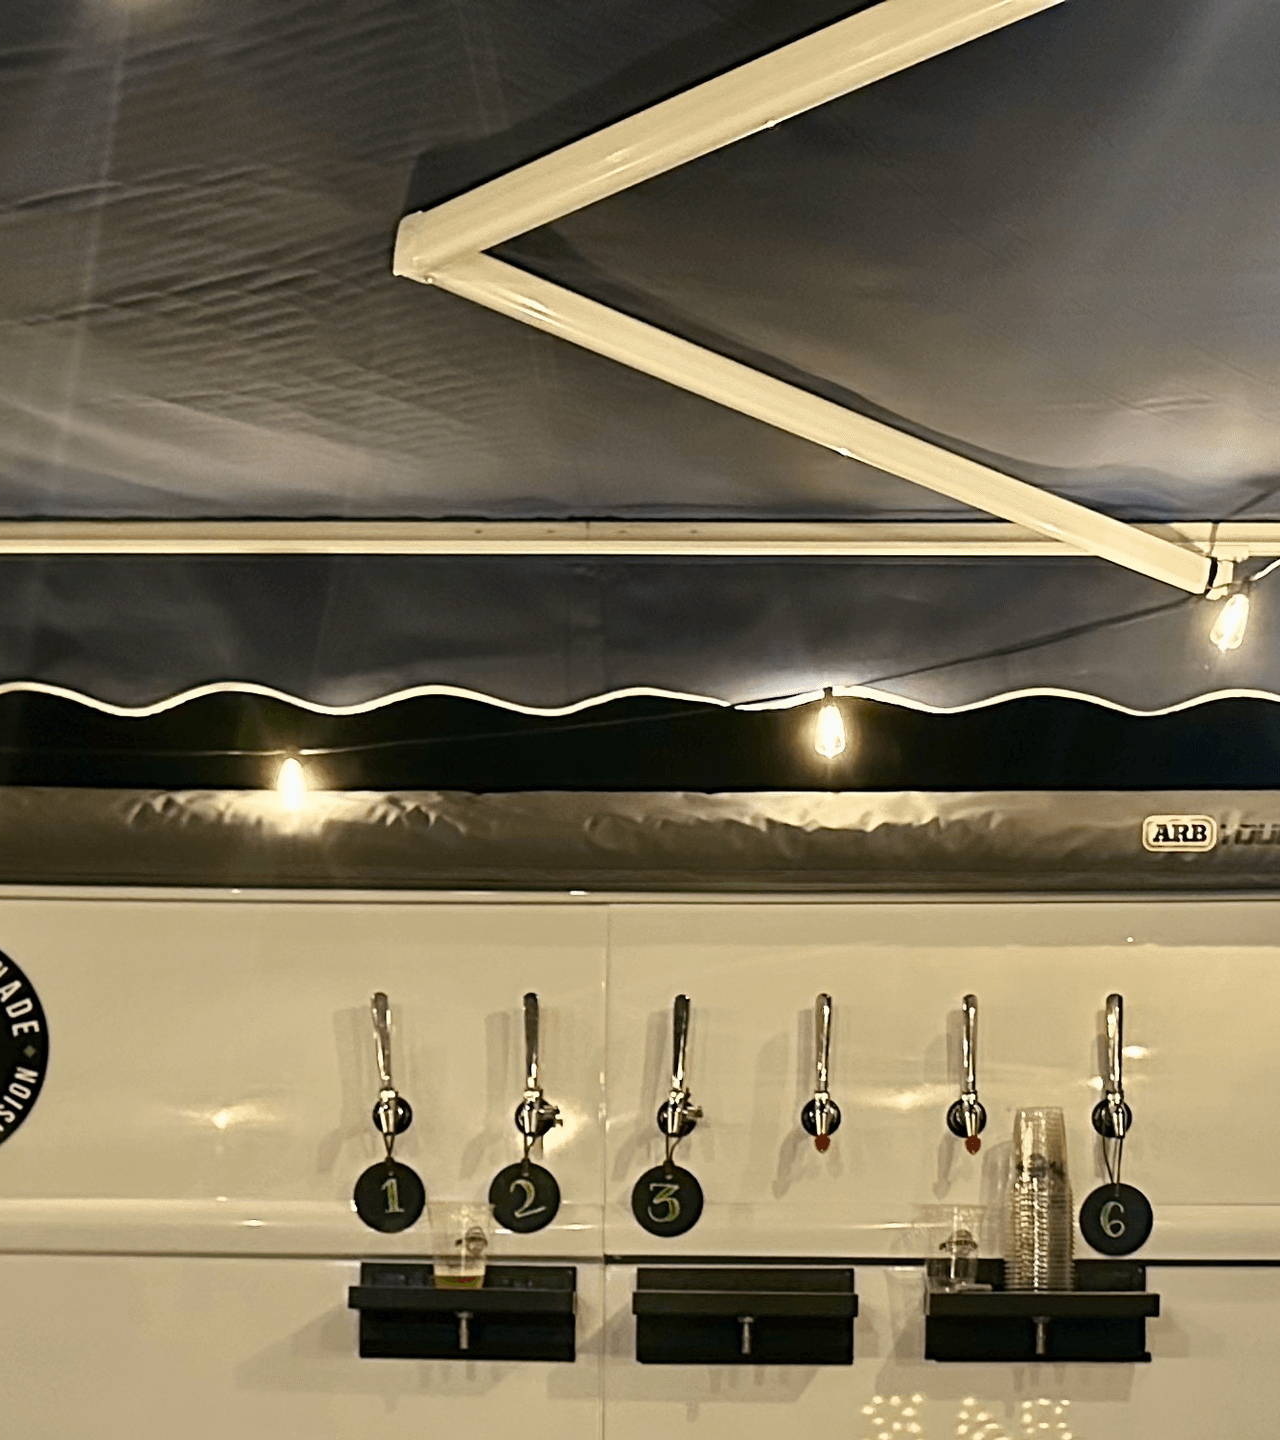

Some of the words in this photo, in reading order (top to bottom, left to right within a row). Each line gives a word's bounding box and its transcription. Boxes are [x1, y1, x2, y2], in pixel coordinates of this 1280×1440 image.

[1152, 824, 1207, 842] ARB
[380, 1178, 405, 1214] 1
[509, 1179, 546, 1219] 2
[647, 1182, 680, 1223] 3
[1101, 1200, 1126, 1238] 6
